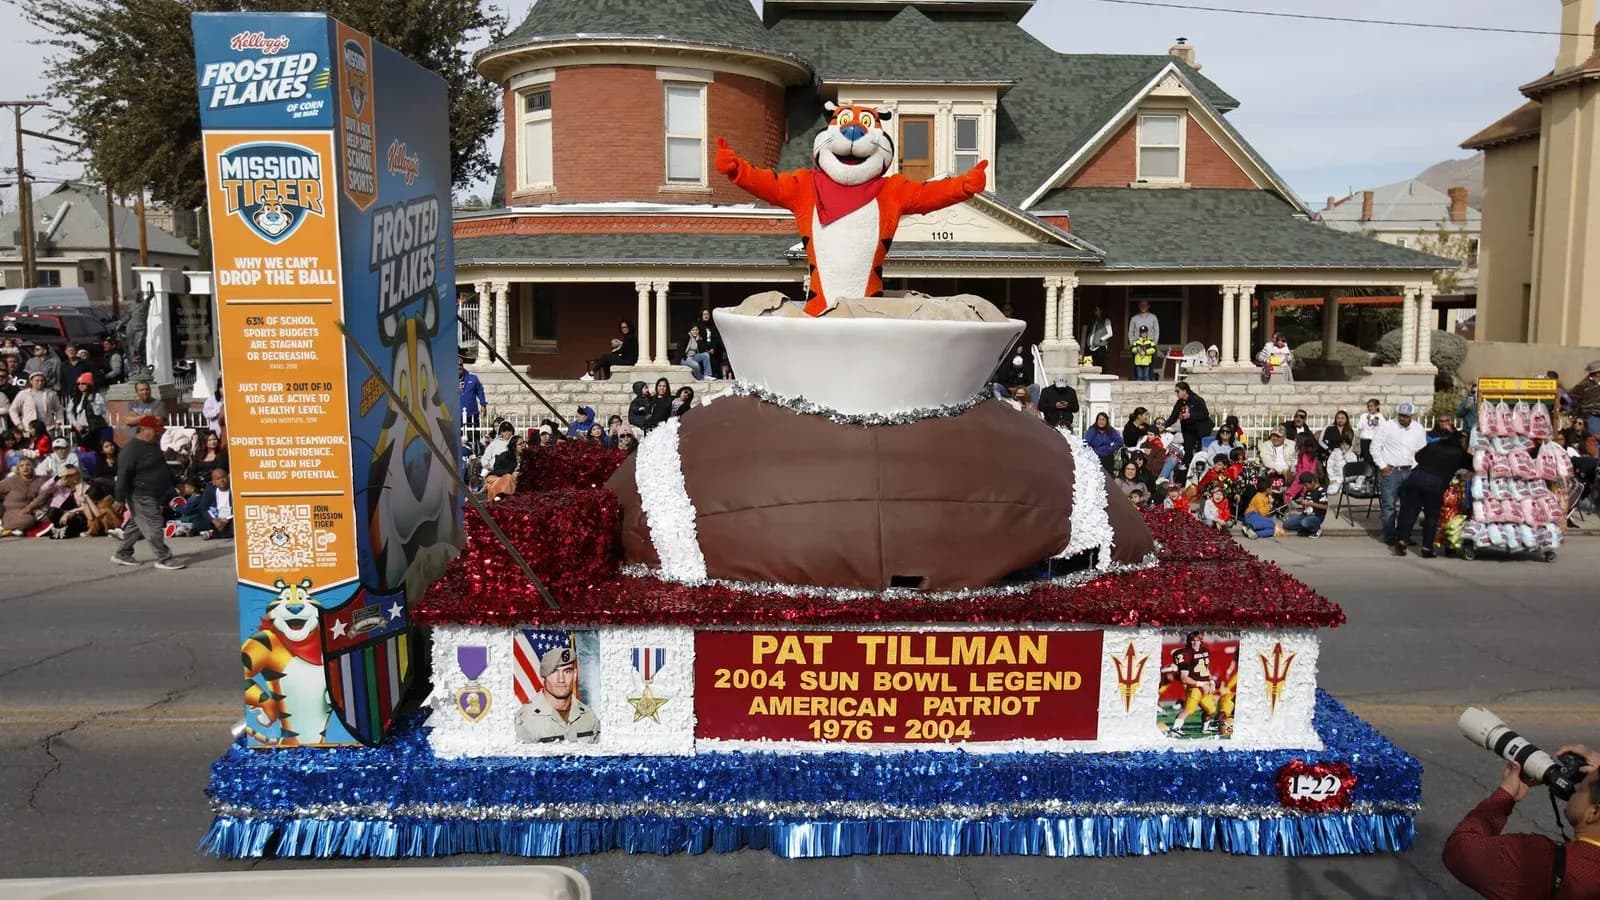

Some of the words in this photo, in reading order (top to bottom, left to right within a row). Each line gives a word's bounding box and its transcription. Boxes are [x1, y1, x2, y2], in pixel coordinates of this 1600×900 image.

[231, 31, 290, 54] Kellogg's
[202, 52, 318, 87] FROSTED
[210, 75, 308, 108] FLAKES
[287, 103, 299, 112] OF
[300, 100, 324, 110] CORN
[221, 156, 319, 179] MISSION
[347, 148, 373, 173] SCHOOL
[349, 169, 375, 194] SPORTS
[222, 179, 323, 213] TIGER
[372, 199, 438, 264] FROSTED
[931, 231, 954, 240] 1101
[234, 257, 262, 269] WHY
[264, 257, 284, 269] WE
[285, 256, 319, 268] CAN'T
[220, 270, 262, 285] DROP
[264, 269, 295, 285] THE
[298, 269, 336, 285] BALL
[379, 243, 435, 315] FLAKES
[246, 316, 265, 326] 63%
[266, 316, 279, 326] OF
[280, 316, 316, 325] SCHOOL
[243, 328, 277, 337] SPORTS
[279, 328, 319, 337] BUDGETS
[250, 340, 268, 349] ARE
[270, 340, 314, 349] STAGNANT
[247, 352, 259, 361] OR
[238, 383, 258, 392] JUST
[261, 383, 283, 391] OVER
[293, 383, 309, 391] OUT
[311, 383, 321, 391] OF
[323, 382, 332, 391] 10
[245, 394, 265, 403] KIDS
[267, 394, 285, 403] ARE
[287, 394, 316, 402] ACTIVE
[319, 393, 330, 402] TO
[250, 406, 256, 415] A
[258, 406, 296, 414] HEALTHY
[231, 437, 264, 446] SPORTS
[266, 437, 293, 445] TEACH
[249, 448, 274, 457] BUILD
[259, 460, 277, 468] AND
[279, 460, 296, 468] CAN
[299, 459, 321, 468] HELP
[243, 471, 264, 480] FUEL
[752, 634, 832, 665] PAT
[857, 634, 1048, 665] TILLMAN
[714, 668, 786, 689] 2004
[800, 671, 859, 692] SUN
[873, 671, 957, 692] BOWL
[969, 671, 1082, 691] LEGEND
[748, 696, 897, 717] AMERICAN
[923, 696, 1041, 716] PATRIOT
[808, 720, 873, 740] 1976
[904, 719, 972, 740] 2004
